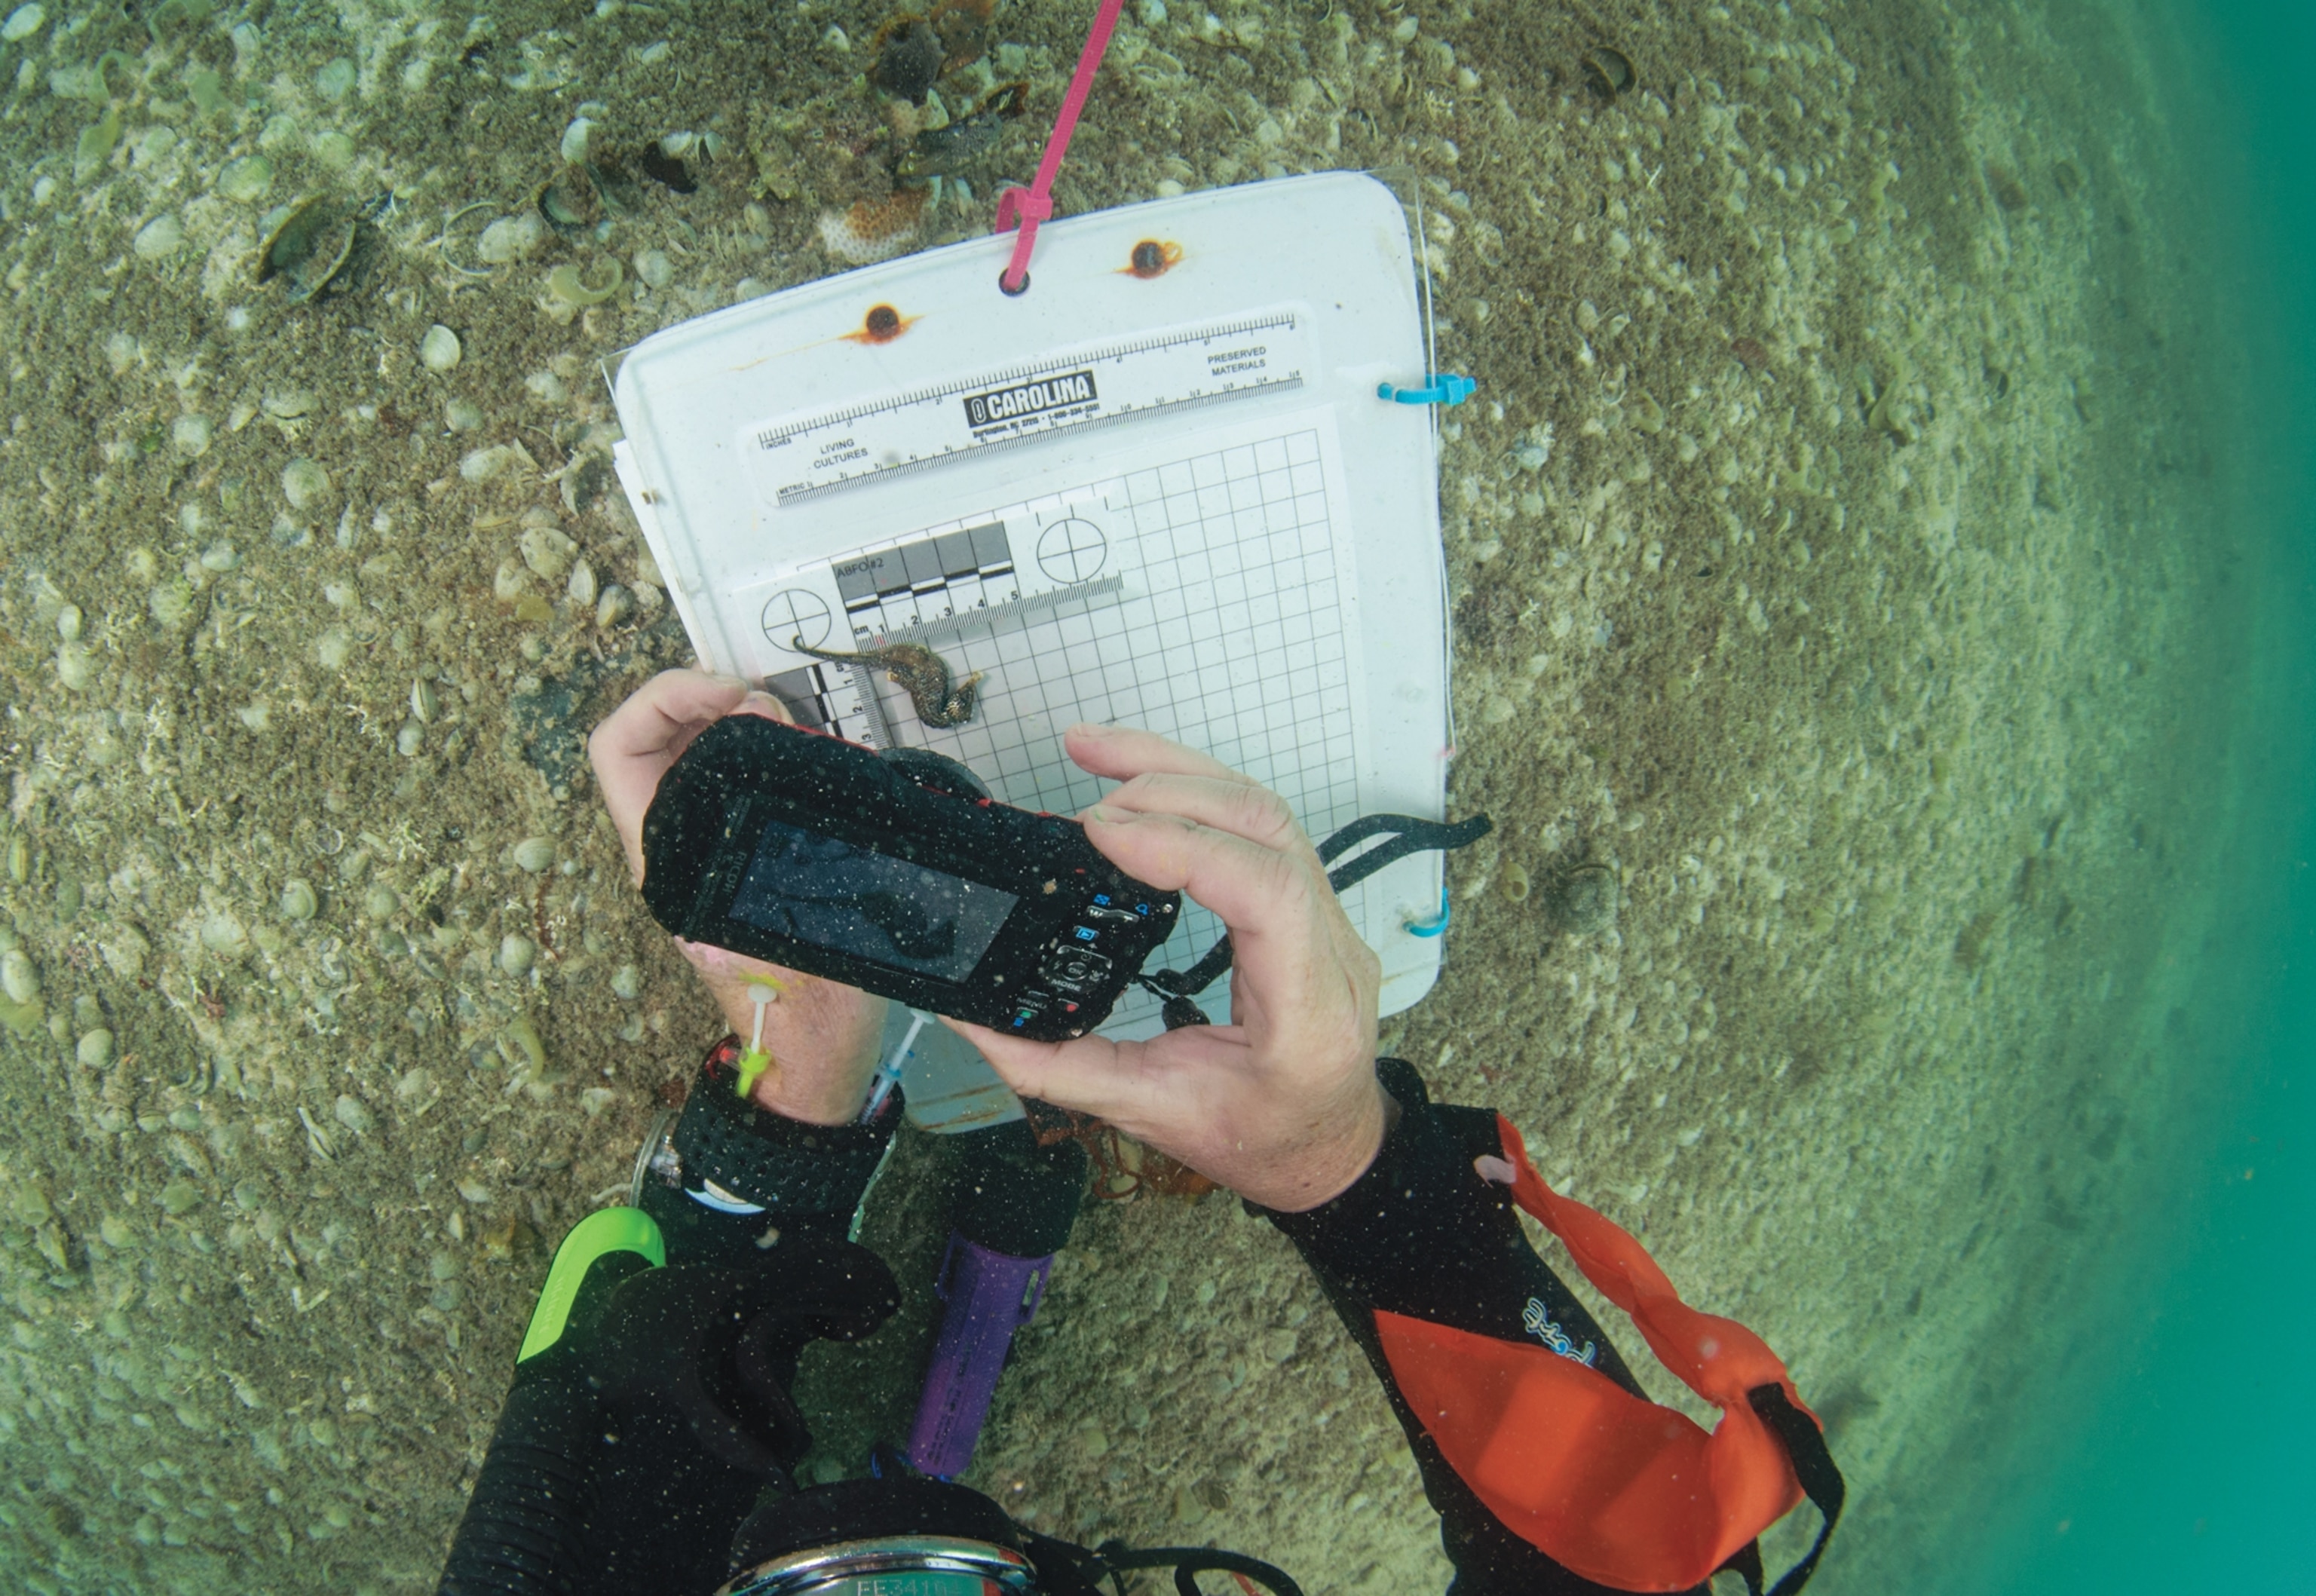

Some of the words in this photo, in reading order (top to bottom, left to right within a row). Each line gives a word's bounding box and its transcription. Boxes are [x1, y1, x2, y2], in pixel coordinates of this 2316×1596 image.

[1207, 346, 1267, 364] PRESERVED
[1212, 359, 1267, 376] MATERIALS
[986, 375, 1091, 420] CAROLINA
[765, 437, 792, 450] INCHES
[820, 438, 854, 454] LIVING
[813, 448, 868, 469] CULTURES
[779, 482, 805, 495] METRIC
[836, 560, 868, 578] ABFO
[870, 558, 884, 570] #2
[854, 625, 869, 636] cm
[878, 623, 885, 633] 1
[911, 615, 918, 625] 2
[944, 607, 952, 617] 3
[978, 599, 985, 608] 4
[1011, 590, 1018, 600] 5
[722, 850, 747, 893] RICOH
[1089, 909, 1103, 918] W
[1068, 967, 1084, 976] OK
[1051, 979, 1082, 991] MODE
[1016, 997, 1047, 1009] MENU
